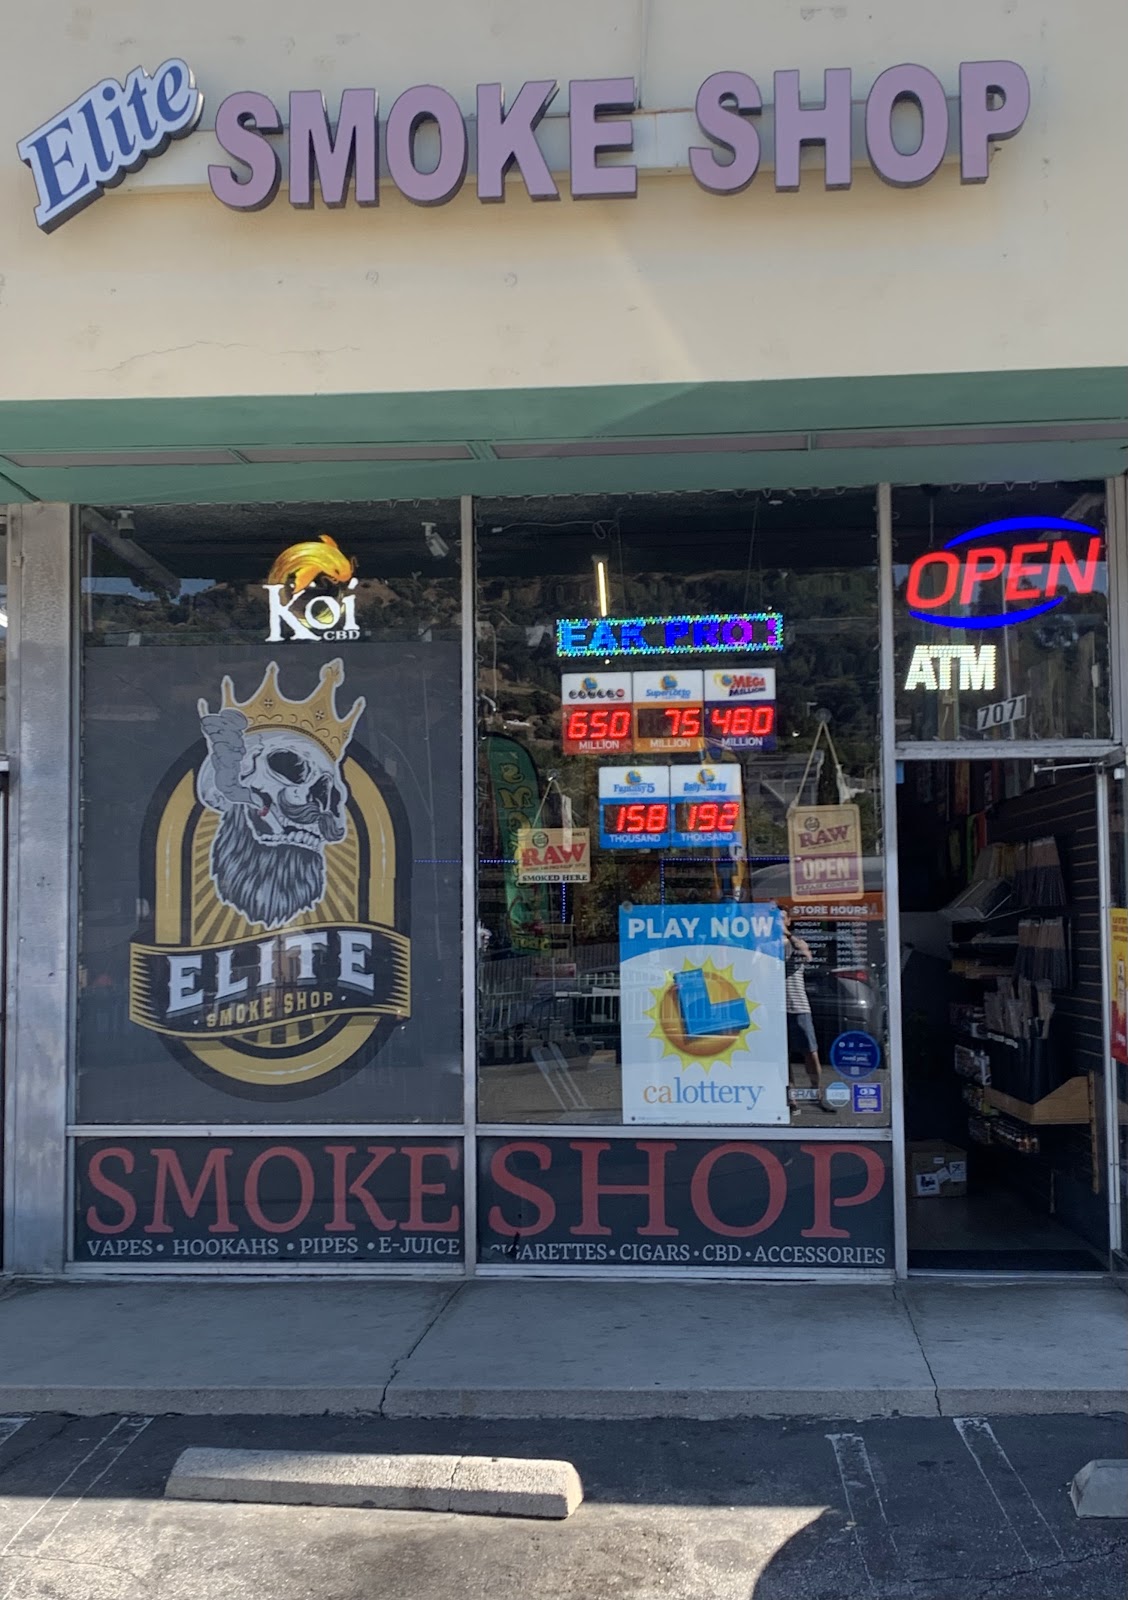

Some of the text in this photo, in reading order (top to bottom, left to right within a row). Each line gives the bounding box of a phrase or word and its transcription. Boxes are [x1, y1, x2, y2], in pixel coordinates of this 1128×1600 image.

[20, 60, 1031, 222] Elite SMOKE SHOP
[906, 537, 1101, 609] OPEN
[262, 577, 360, 641] Koi
[323, 630, 360, 641] CBD
[904, 644, 997, 691] ATM
[731, 675, 766, 689] MEGA
[568, 709, 631, 739] 650
[665, 707, 701, 737] 75
[711, 705, 774, 736] 480
[579, 738, 620, 750] MILLION
[650, 737, 691, 749] MILLION
[721, 735, 763, 748] MILLION
[616, 803, 669, 833] 158
[687, 802, 740, 832] 192
[609, 834, 661, 844] THOUSAND
[681, 832, 734, 842] THOUSAND
[799, 825, 850, 848] RAW
[522, 843, 587, 867] RAW
[523, 874, 560, 882] SMOKED
[803, 857, 850, 880] OPEN
[793, 905, 869, 915] STORE HOURS
[628, 916, 774, 939] PLAY NOW
[166, 931, 375, 1015] ELITE
[206, 991, 334, 1028] SMOKE SHOP
[643, 1077, 764, 1110] calottery
[86, 1146, 461, 1235] SMOKE
[488, 1142, 886, 1238] SHOP
[86, 1237, 460, 1256] VAPES HOOKAHS PIPES E-JUICE
[619, 1244, 690, 1261] CIGARS
[702, 1245, 742, 1262] CBD
[755, 1246, 886, 1264] ACCESSORIES
